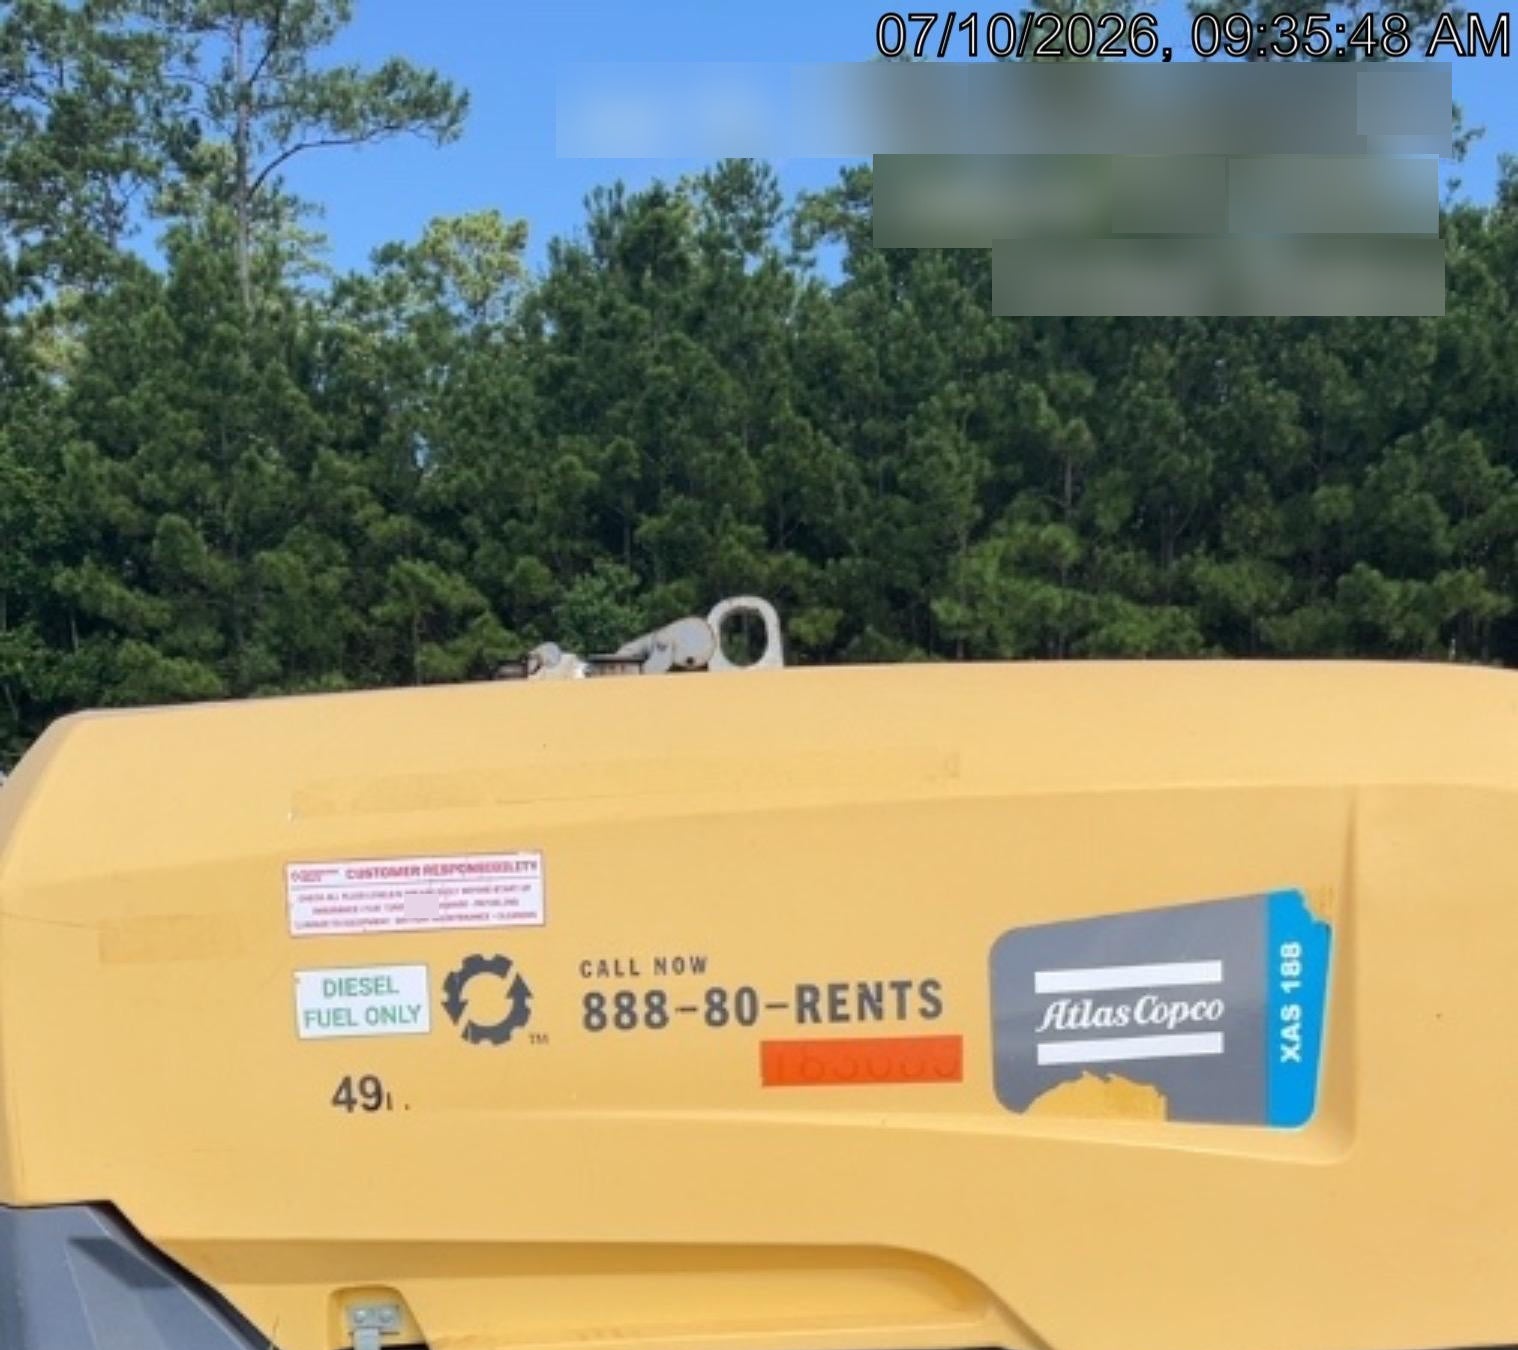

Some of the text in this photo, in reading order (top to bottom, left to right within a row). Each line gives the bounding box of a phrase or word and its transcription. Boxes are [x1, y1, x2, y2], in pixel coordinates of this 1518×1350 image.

[344, 865, 421, 880] CUSTOMER
[578, 955, 708, 979] CALL NOW
[322, 976, 400, 998] DIESEL
[581, 978, 944, 1033] 888-80-RENTS
[1279, 941, 1303, 1063] XAS 188
[303, 1004, 423, 1029] FUEL ONLY
